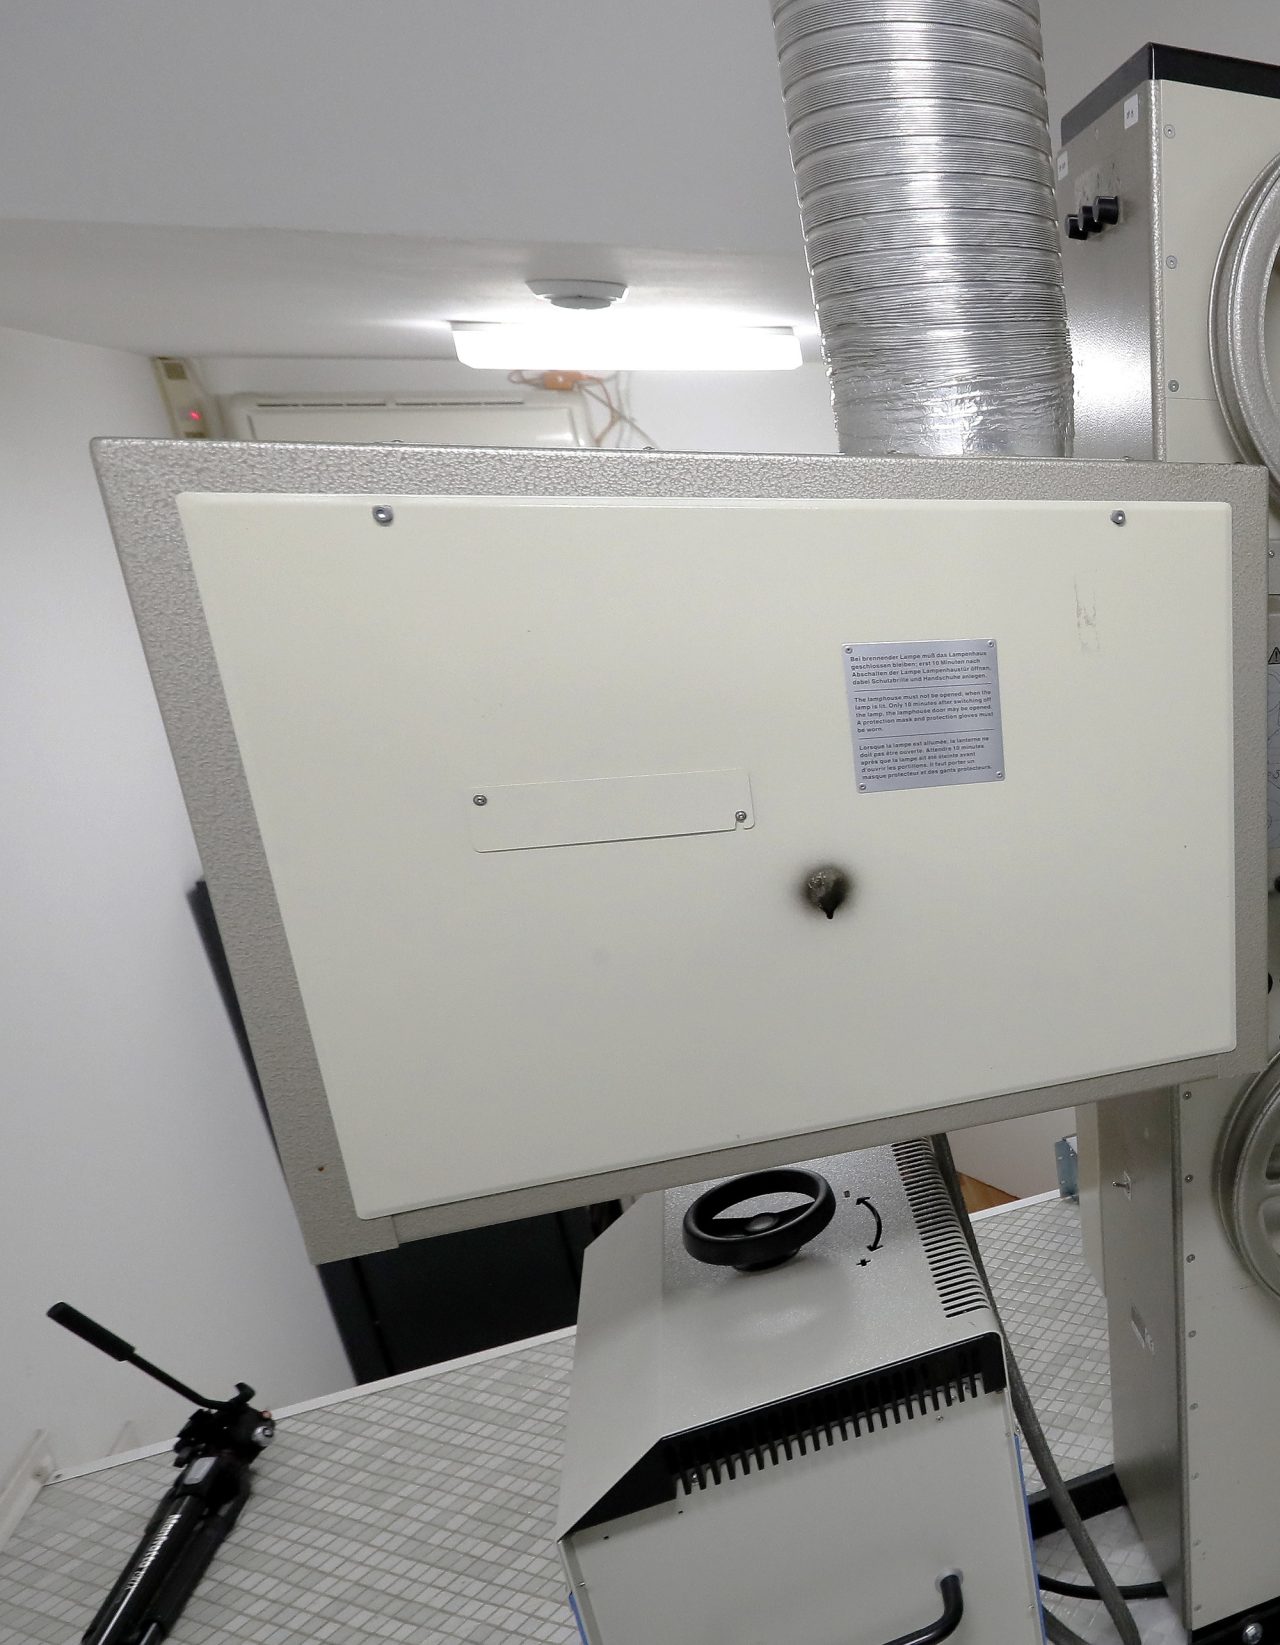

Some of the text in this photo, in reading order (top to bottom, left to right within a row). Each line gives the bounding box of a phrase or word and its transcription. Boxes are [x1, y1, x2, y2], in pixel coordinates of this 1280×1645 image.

[851, 662, 891, 670] geschlossen
[862, 718, 895, 726] protection
[926, 714, 957, 722] protection
